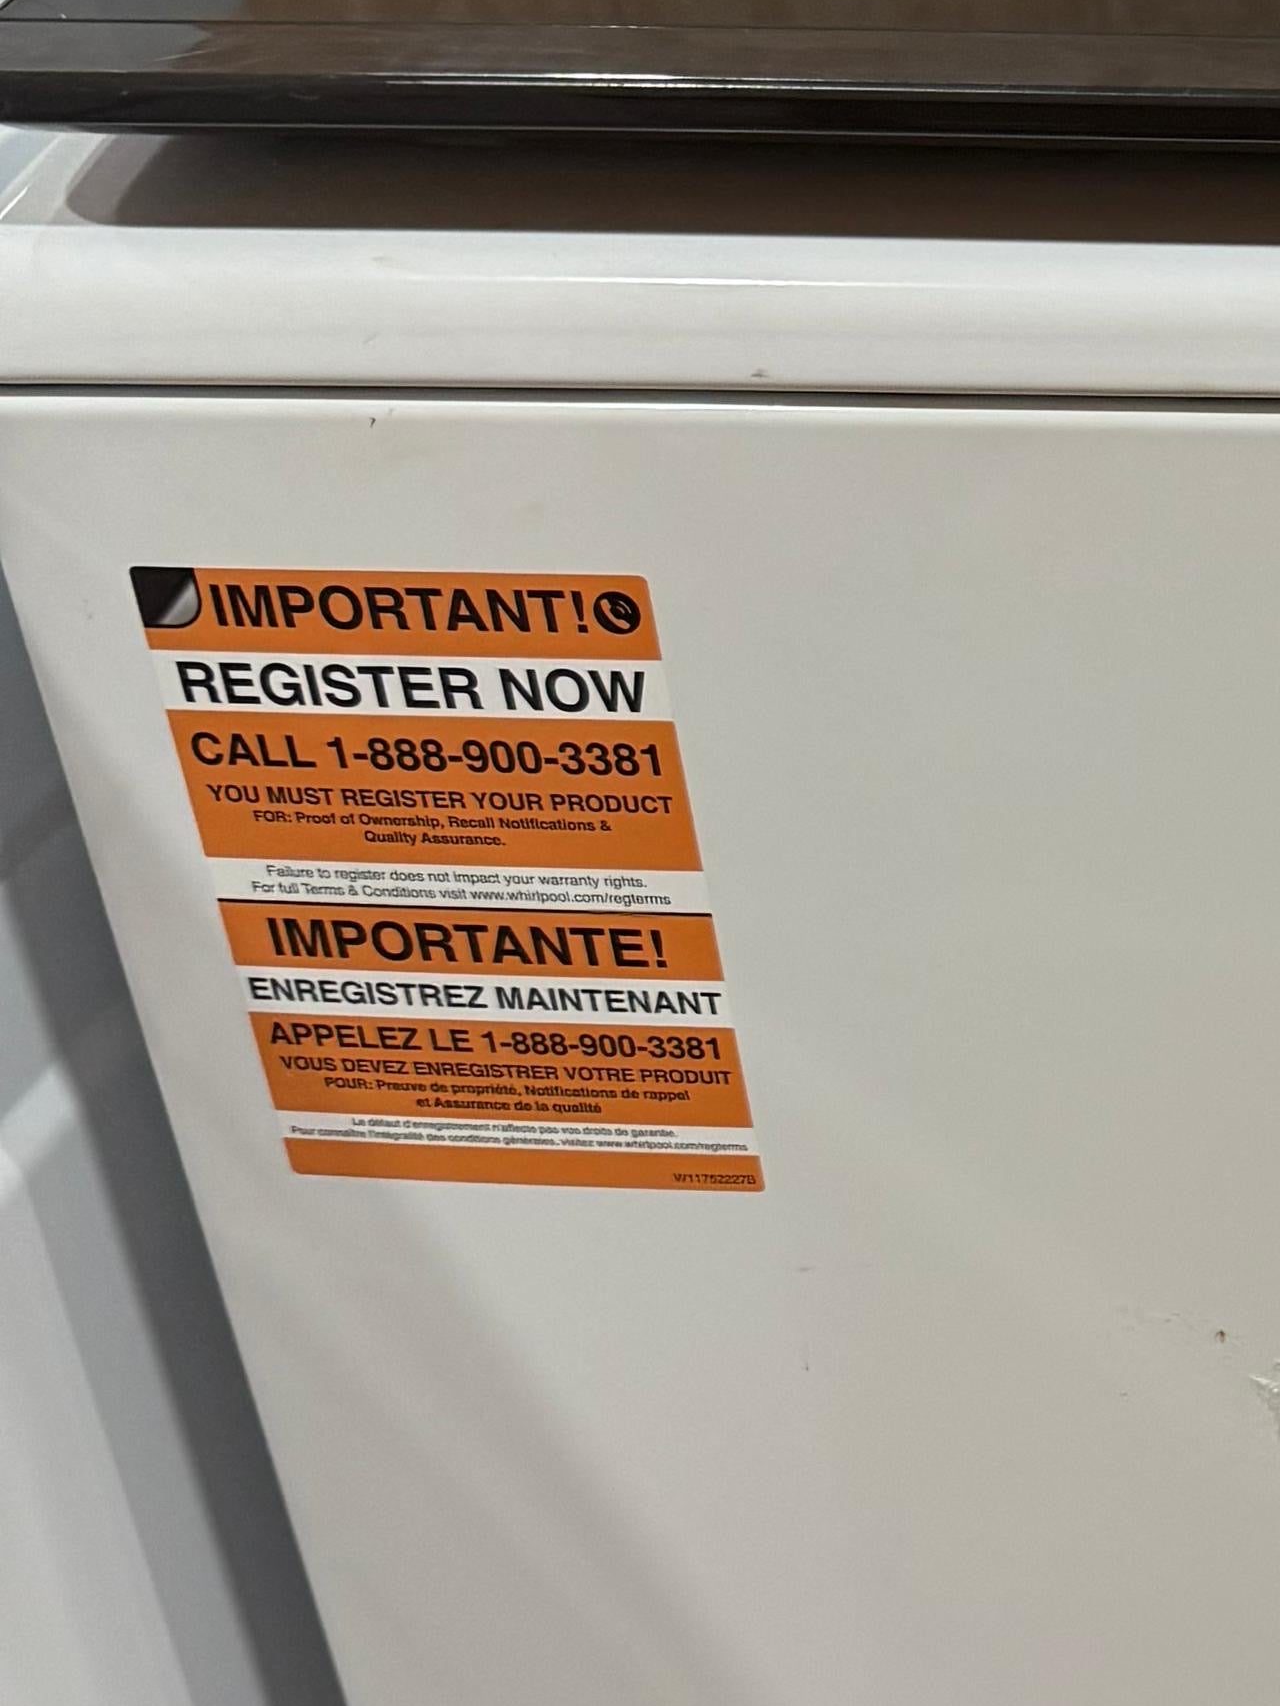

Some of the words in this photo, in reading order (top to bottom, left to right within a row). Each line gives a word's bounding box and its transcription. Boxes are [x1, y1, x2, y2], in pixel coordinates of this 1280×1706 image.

[208, 583, 589, 634] IMPORTANT!
[175, 660, 485, 709] REGISTER
[497, 668, 646, 713] NOW
[190, 731, 318, 769] CALL
[326, 736, 662, 777] 1-888-900-3381
[206, 783, 261, 804] YOU
[266, 785, 334, 807] MUST
[341, 787, 467, 810] REGISTER
[470, 792, 545, 812] YOUR
[550, 794, 674, 815] PRODUCT
[252, 809, 293, 824] FOR:
[295, 810, 337, 826] Proof
[339, 814, 356, 826] of
[358, 813, 446, 831] Ownership,
[448, 815, 496, 831] Recall
[499, 817, 597, 833] Notifications
[600, 820, 613, 832] &
[363, 830, 418, 848] Quality
[420, 831, 507, 848] Assurance.
[266, 864, 315, 880] Failure
[317, 867, 332, 880] to
[334, 868, 386, 884] register
[389, 870, 426, 883] does
[427, 871, 452, 885] not
[453, 871, 502, 889] impact
[503, 875, 536, 890] your
[538, 875, 601, 890] warranty
[603, 876, 649, 891] rights.
[251, 880, 276, 894] For
[278, 881, 301, 895] full
[301, 882, 346, 897] Terms
[347, 884, 361, 896] &
[362, 884, 437, 900] Conditions
[438, 887, 468, 901] visit
[470, 888, 673, 908] www.whirlpool.com/regterms
[266, 917, 669, 969] IMPORTANTE!
[247, 976, 489, 1009] ENREGISTREZ
[494, 986, 722, 1015] MAINTENANT
[269, 1021, 423, 1051] APPELEZ
[428, 1028, 475, 1053] LE
[480, 1030, 722, 1061] 1-888-900-3381
[279, 1055, 338, 1072] VOUS
[342, 1058, 409, 1075] DEVEZ
[414, 1061, 559, 1080] ENREGISTRER
[563, 1066, 636, 1083] VOTRE
[639, 1068, 732, 1086] PRODUIT
[323, 1076, 375, 1090] POUR:
[376, 1078, 427, 1093] Preuve
[429, 1080, 449, 1093] de
[450, 1081, 522, 1098] propriété,
[524, 1084, 618, 1100] Notifications
[620, 1088, 640, 1101] de
[642, 1089, 691, 1103] rappel
[415, 1097, 431, 1109] et
[433, 1097, 512, 1113] Assurance
[513, 1100, 533, 1113] de
[535, 1100, 551, 1113] la
[551, 1101, 603, 1117] qualité
